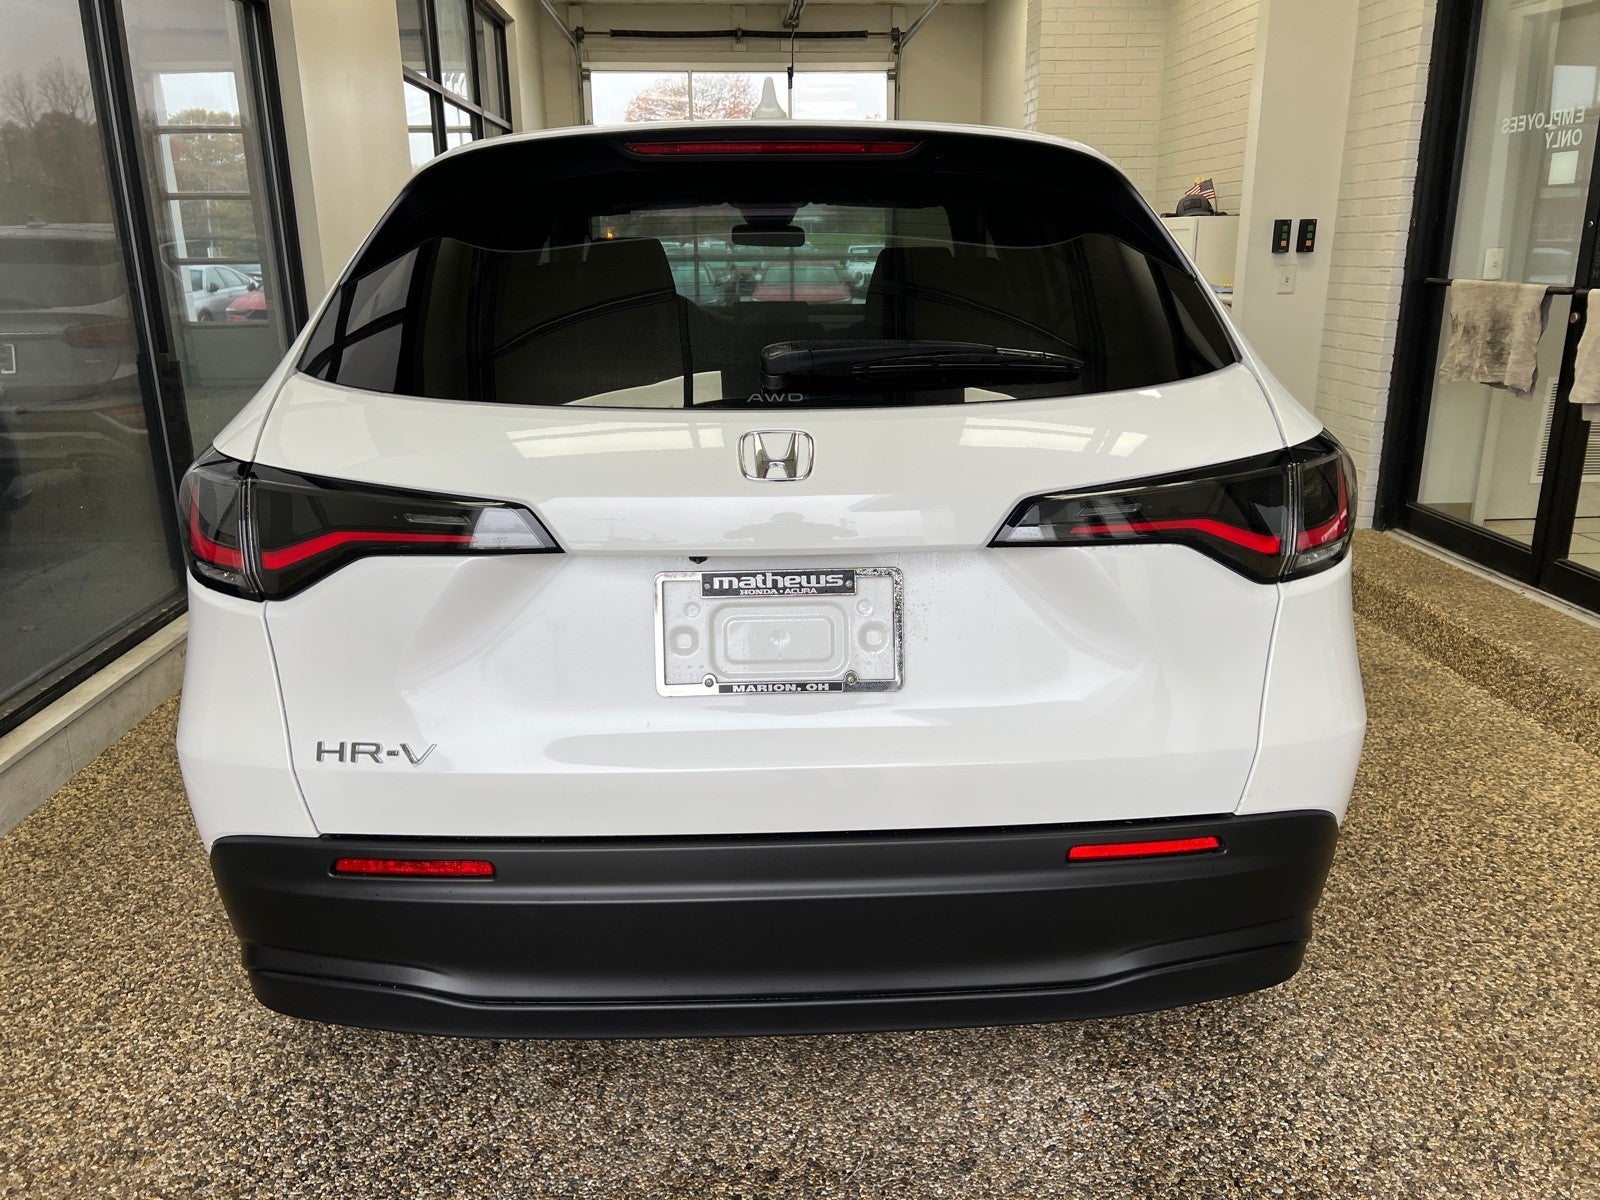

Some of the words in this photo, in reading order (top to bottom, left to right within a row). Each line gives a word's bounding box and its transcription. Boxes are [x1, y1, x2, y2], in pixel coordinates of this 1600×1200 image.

[746, 393, 803, 402] AWD
[713, 573, 845, 590] mathews
[732, 683, 802, 693] MARION,
[805, 683, 829, 691] OH
[316, 741, 437, 767] HR-V
